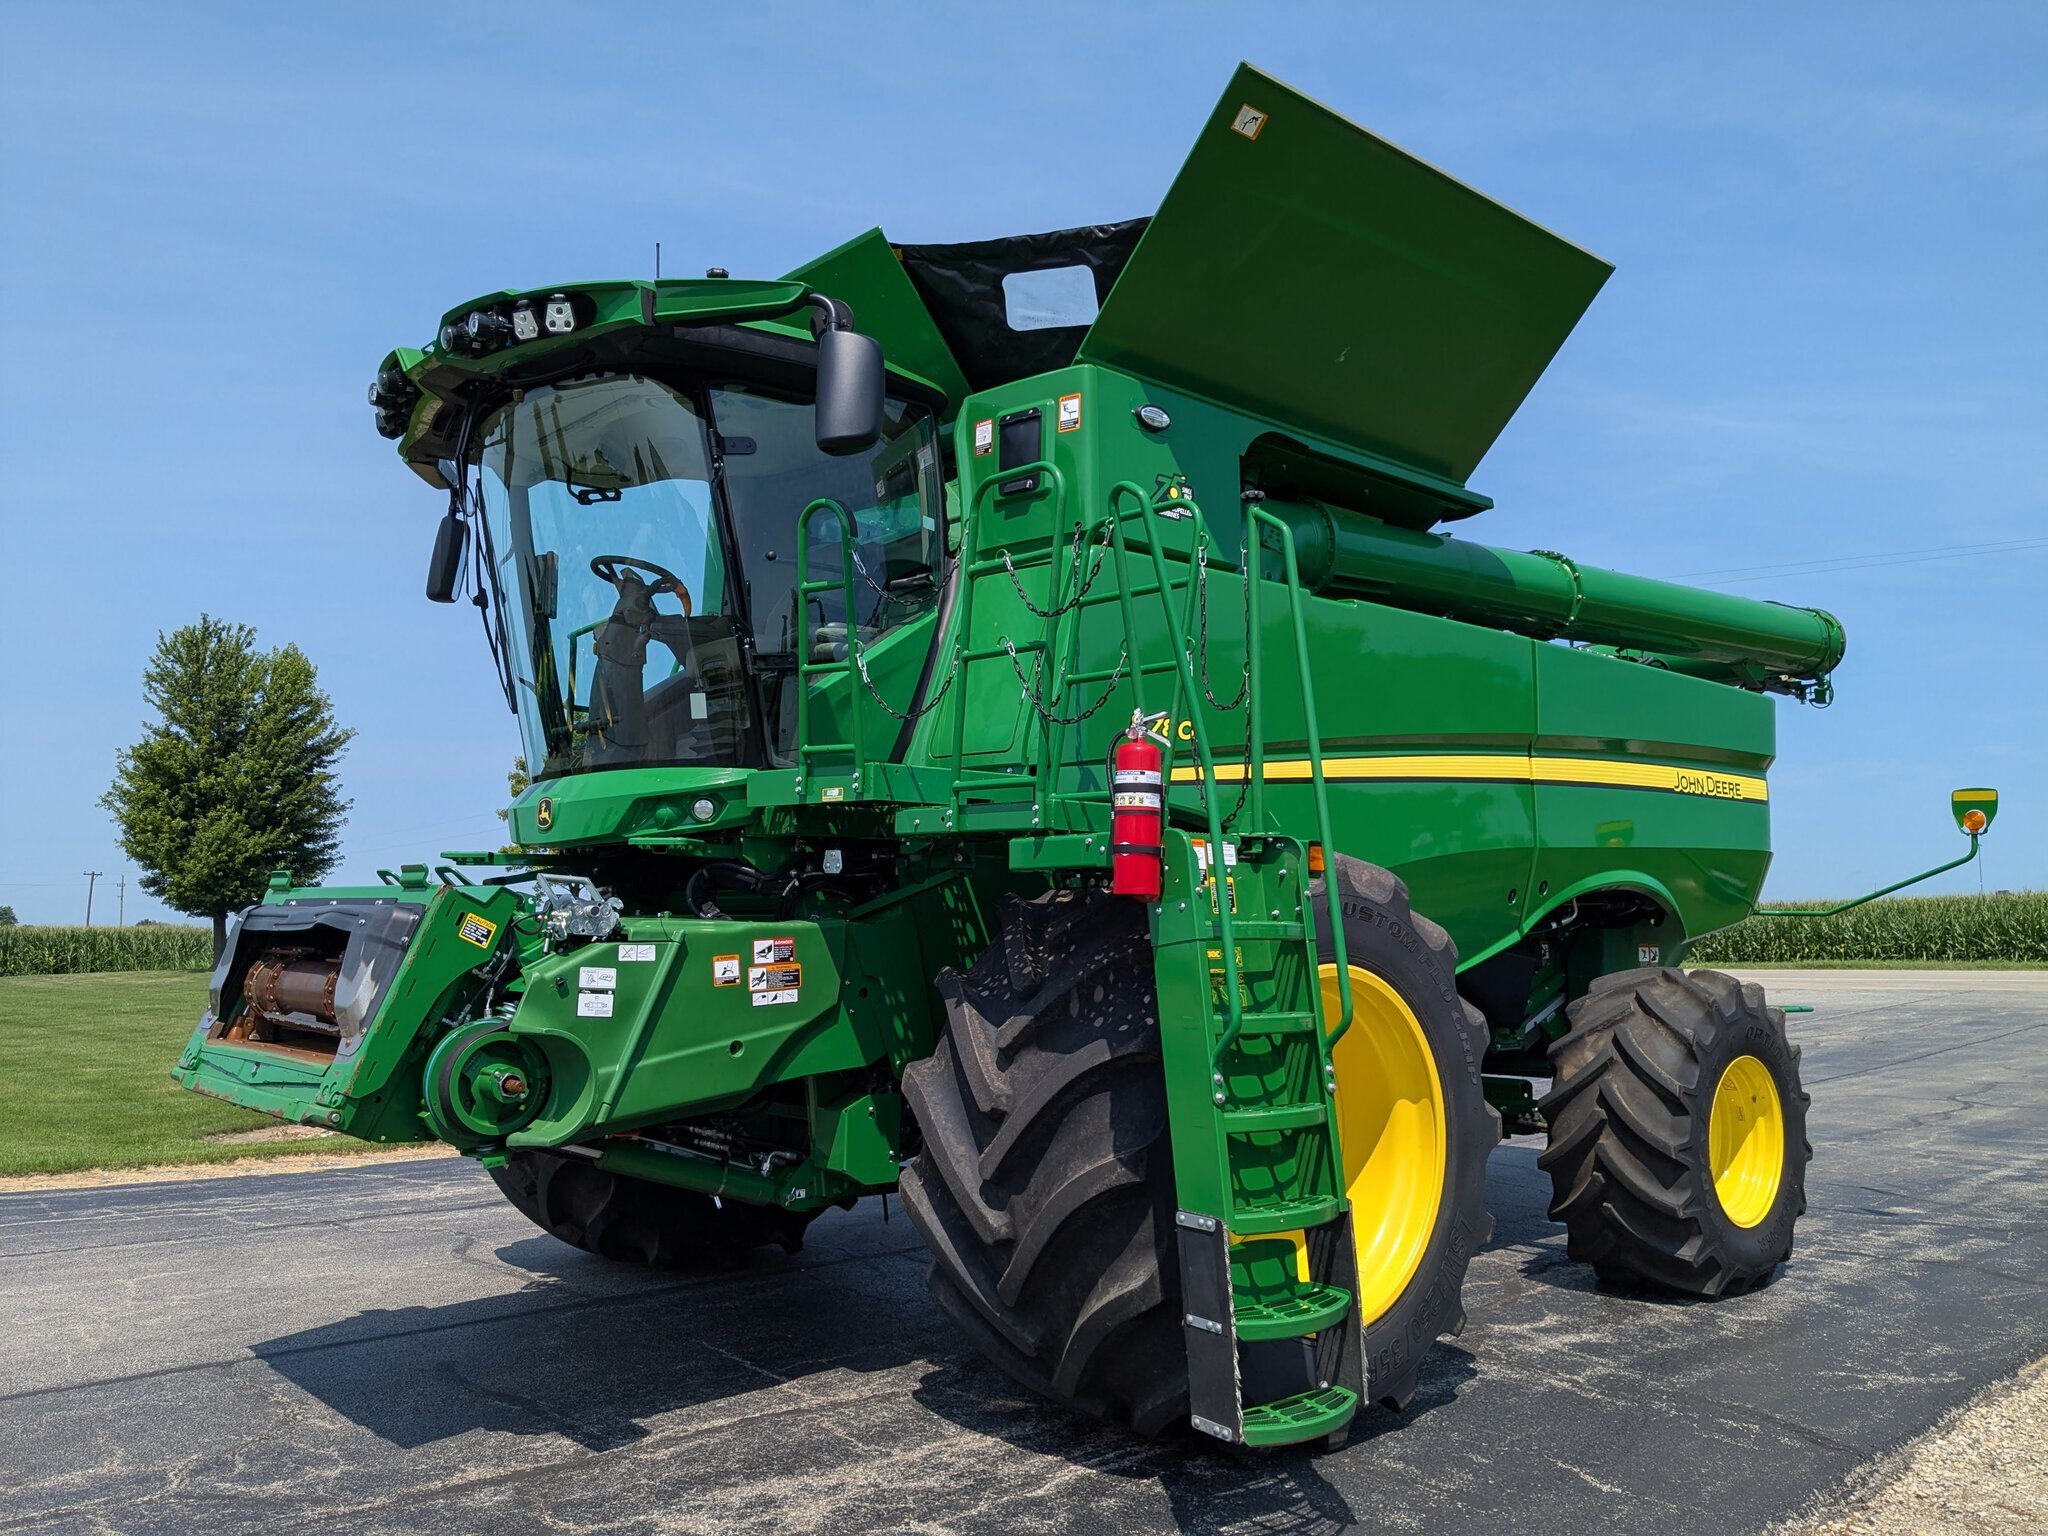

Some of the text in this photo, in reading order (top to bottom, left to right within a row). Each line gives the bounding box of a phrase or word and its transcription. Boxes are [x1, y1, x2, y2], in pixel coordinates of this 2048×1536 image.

[1674, 771, 1742, 797] JOHN DEERE
[1327, 901, 1419, 953] USTOM
